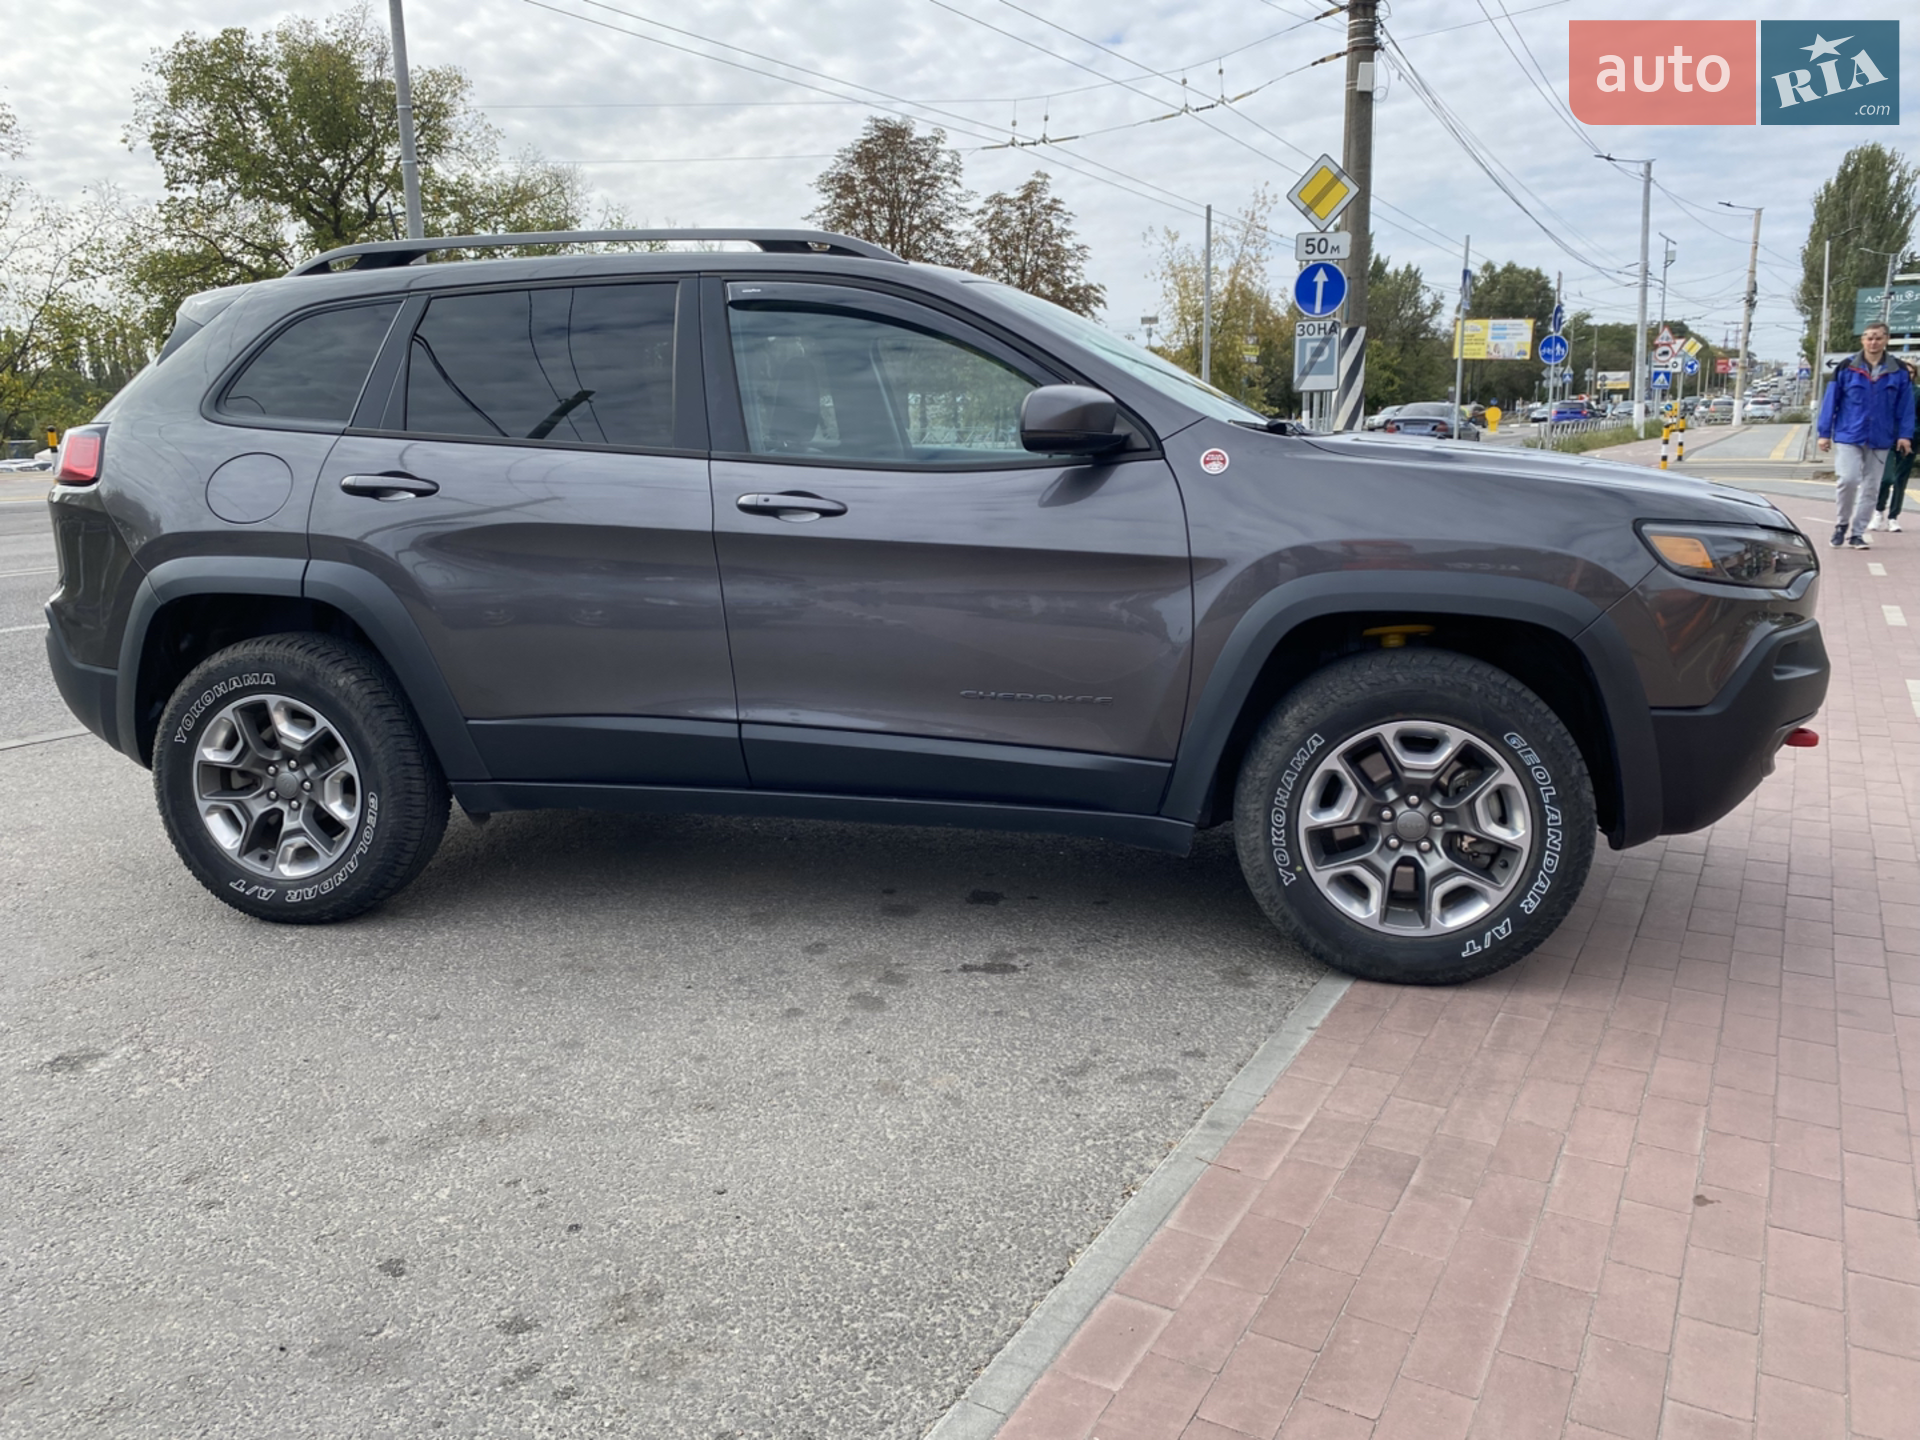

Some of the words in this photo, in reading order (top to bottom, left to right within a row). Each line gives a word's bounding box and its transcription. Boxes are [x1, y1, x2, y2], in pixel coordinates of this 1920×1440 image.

[1296, 322, 1338, 337] ЗОНА
[174, 672, 276, 744] YOKOHAMA
[959, 689, 1114, 706] CHEROKEE
[1271, 733, 1325, 886] YOKOHAMA
[1503, 732, 1563, 914] GEOLANDAR
[285, 791, 378, 903] GEOLANDAR
[230, 878, 276, 900] A/T
[1461, 918, 1512, 957] A/T
